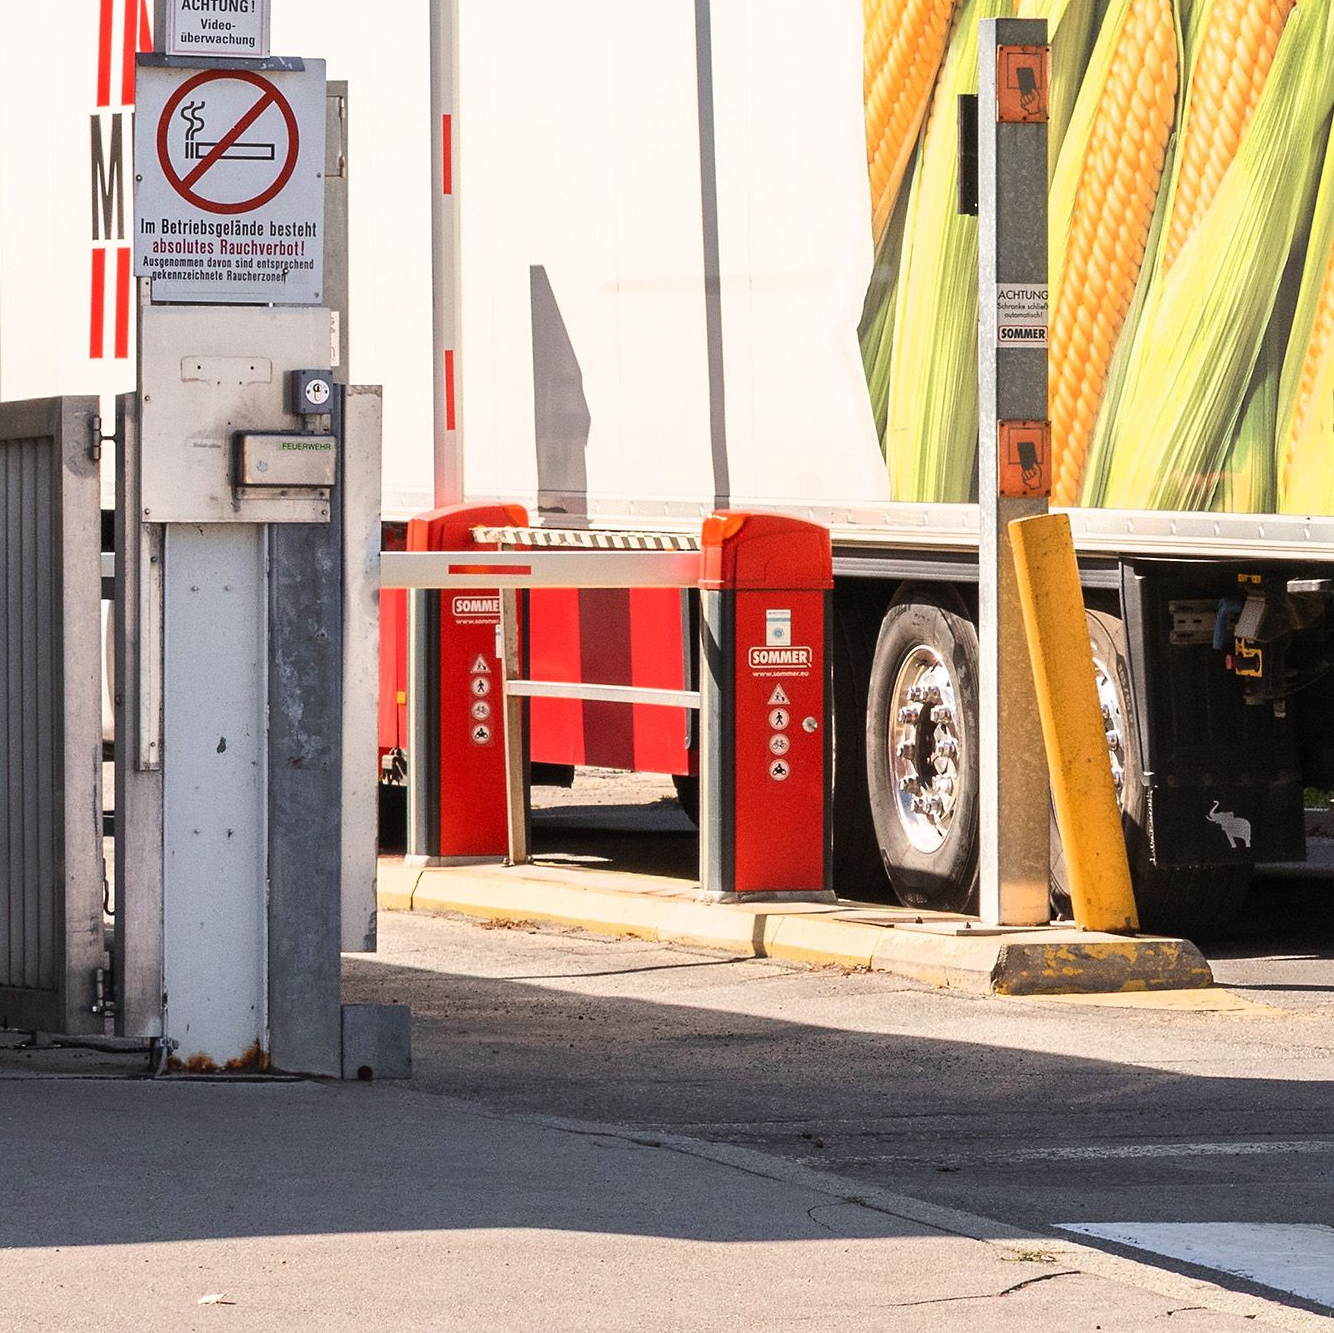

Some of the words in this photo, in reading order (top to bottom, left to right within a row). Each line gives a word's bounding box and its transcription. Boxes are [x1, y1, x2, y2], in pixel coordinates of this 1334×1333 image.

[200, 18, 236, 31] Video-
[180, 32, 256, 48] überwachung
[140, 218, 156, 234] Im
[161, 218, 264, 238] Betriebsgelände
[269, 221, 317, 238] besteht
[152, 238, 214, 254] absolutes
[220, 239, 305, 256] Rauchverbot!
[142, 255, 204, 269] Ausgenommen
[207, 257, 232, 268] davon
[235, 258, 254, 269] sind
[256, 259, 314, 272] entsprechend
[151, 269, 224, 282] gekennzeichnete
[1001, 328, 1045, 339] SOMMER
[282, 442, 331, 451] FEUERWEHR
[456, 599, 499, 612] SOMME
[752, 650, 808, 664] SOMMER
